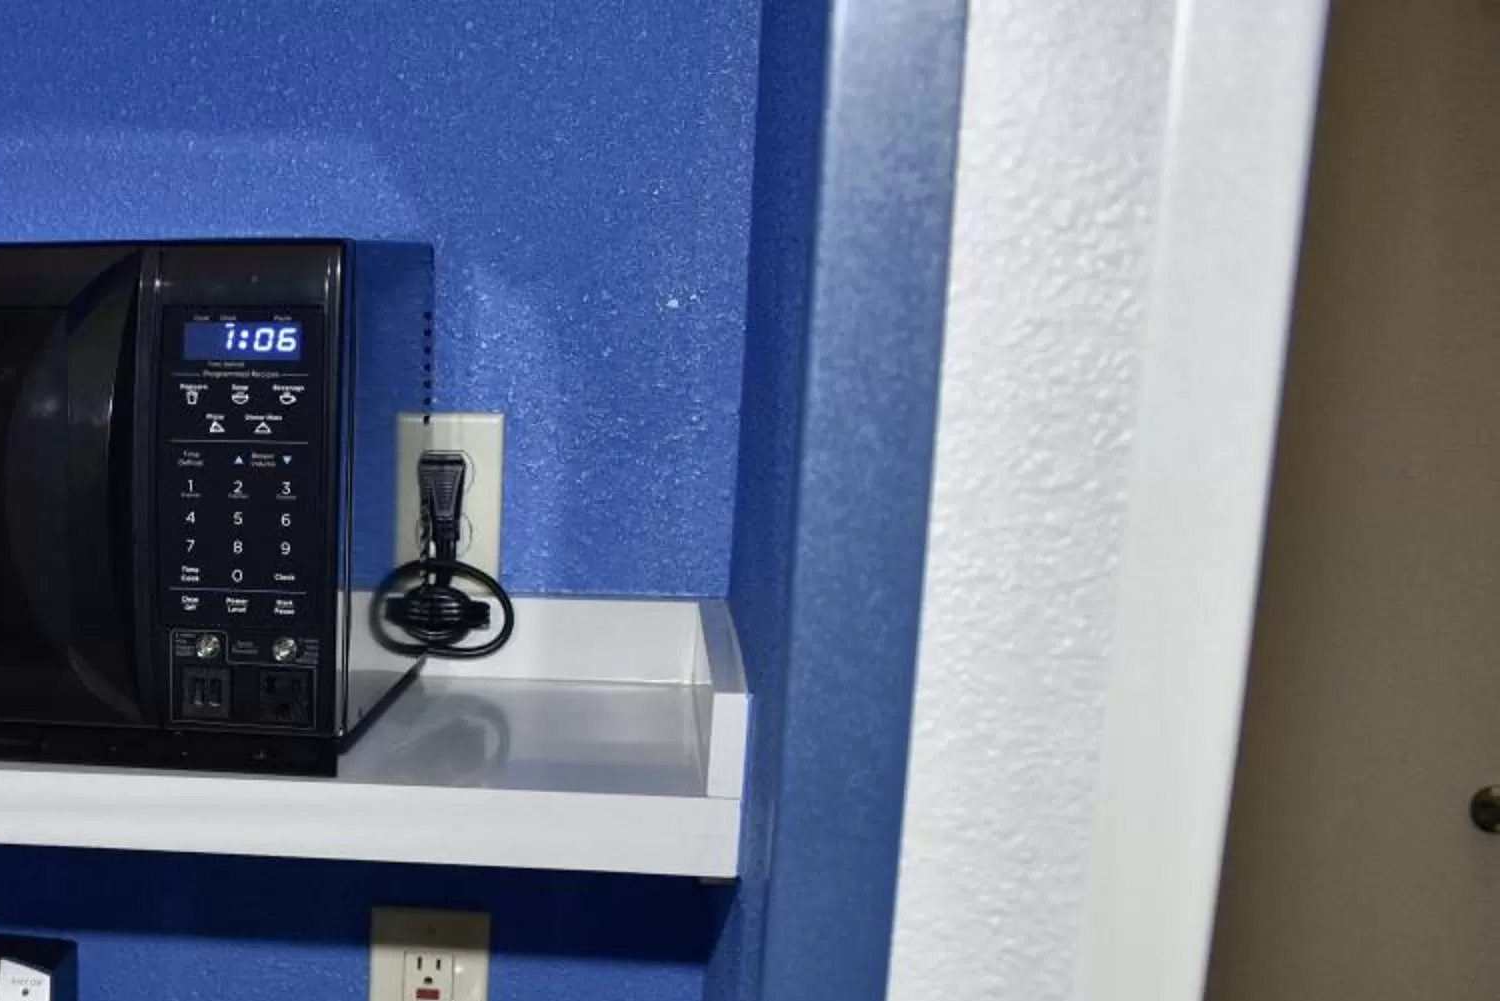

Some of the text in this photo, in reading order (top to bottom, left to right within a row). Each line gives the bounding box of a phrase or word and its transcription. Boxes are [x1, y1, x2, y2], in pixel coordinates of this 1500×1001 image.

[225, 327, 297, 352] 1:06
[187, 479, 194, 493] 1
[233, 480, 243, 494] 2
[282, 481, 291, 495] 3
[185, 511, 196, 524] 4
[233, 511, 243, 525] 5
[281, 513, 291, 527] 6
[186, 539, 195, 552] 7
[233, 540, 243, 554] 8
[281, 541, 291, 555] 9
